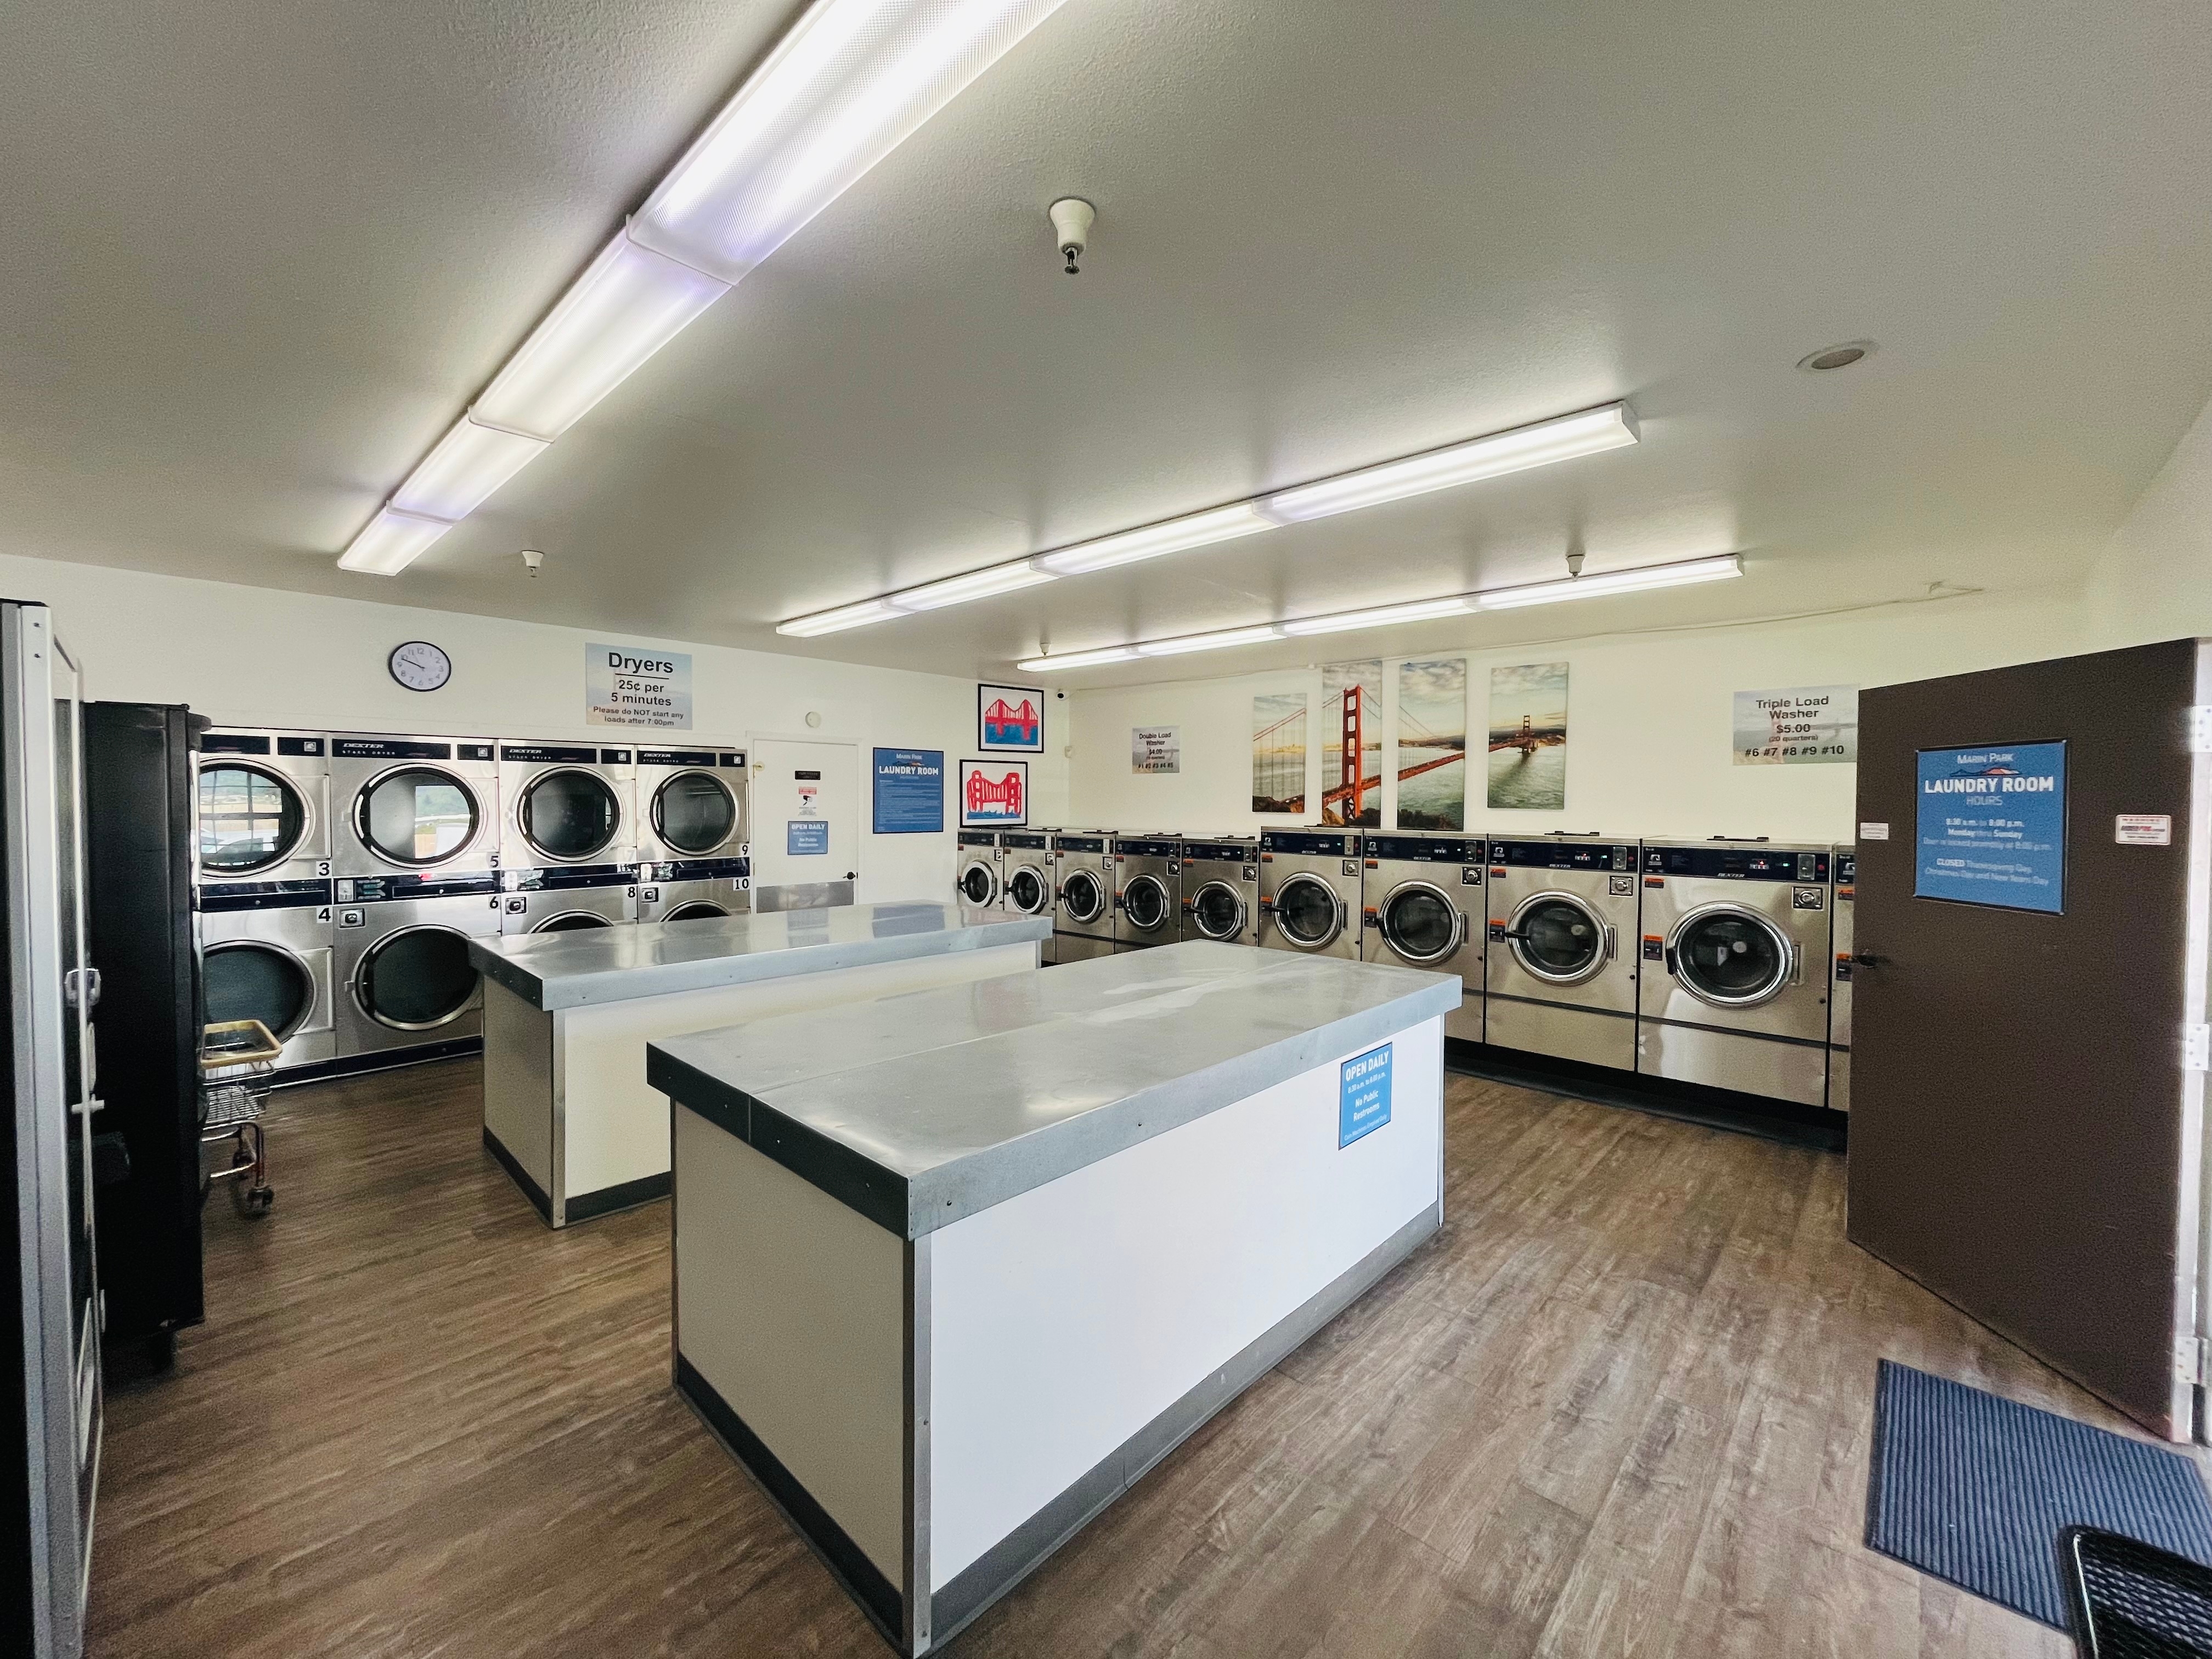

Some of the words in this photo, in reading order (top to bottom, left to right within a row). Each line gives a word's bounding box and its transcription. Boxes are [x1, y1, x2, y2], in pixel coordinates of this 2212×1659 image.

[608, 652, 673, 674] Dryers
[619, 679, 641, 691] 25¢
[645, 683, 664, 693] per
[611, 692, 618, 702] 5
[622, 694, 672, 706] minutes
[1756, 698, 1791, 710] Triple
[1796, 696, 1829, 706] Load
[593, 706, 619, 714] Please
[1769, 709, 1819, 719] Washer
[1776, 724, 1811, 733] $5.00
[1745, 748, 1759, 757] #6
[1764, 747, 1778, 757] #7
[1782, 747, 1797, 755] #8
[1802, 746, 1817, 755] #9
[1821, 745, 1844, 754] #10
[879, 765, 916, 775] LAUNDRY
[917, 767, 939, 775] ROOM
[1925, 778, 1999, 793] LAUNDRY
[2002, 776, 2053, 792] ROOM
[1966, 795, 2002, 805] HOURS
[742, 845, 748, 855] 9
[490, 856, 499, 868] 5
[319, 862, 330, 876] 3
[735, 879, 749, 889] 10
[628, 887, 635, 898] 8
[490, 896, 499, 909] 6
[318, 907, 331, 922] 4
[1346, 1060, 1367, 1081] OPEN
[1368, 1051, 1389, 1071] DAILY
[1356, 1098, 1363, 1108] No
[1363, 1090, 1379, 1104] Public
[1353, 1103, 1380, 1121] Restrooms
